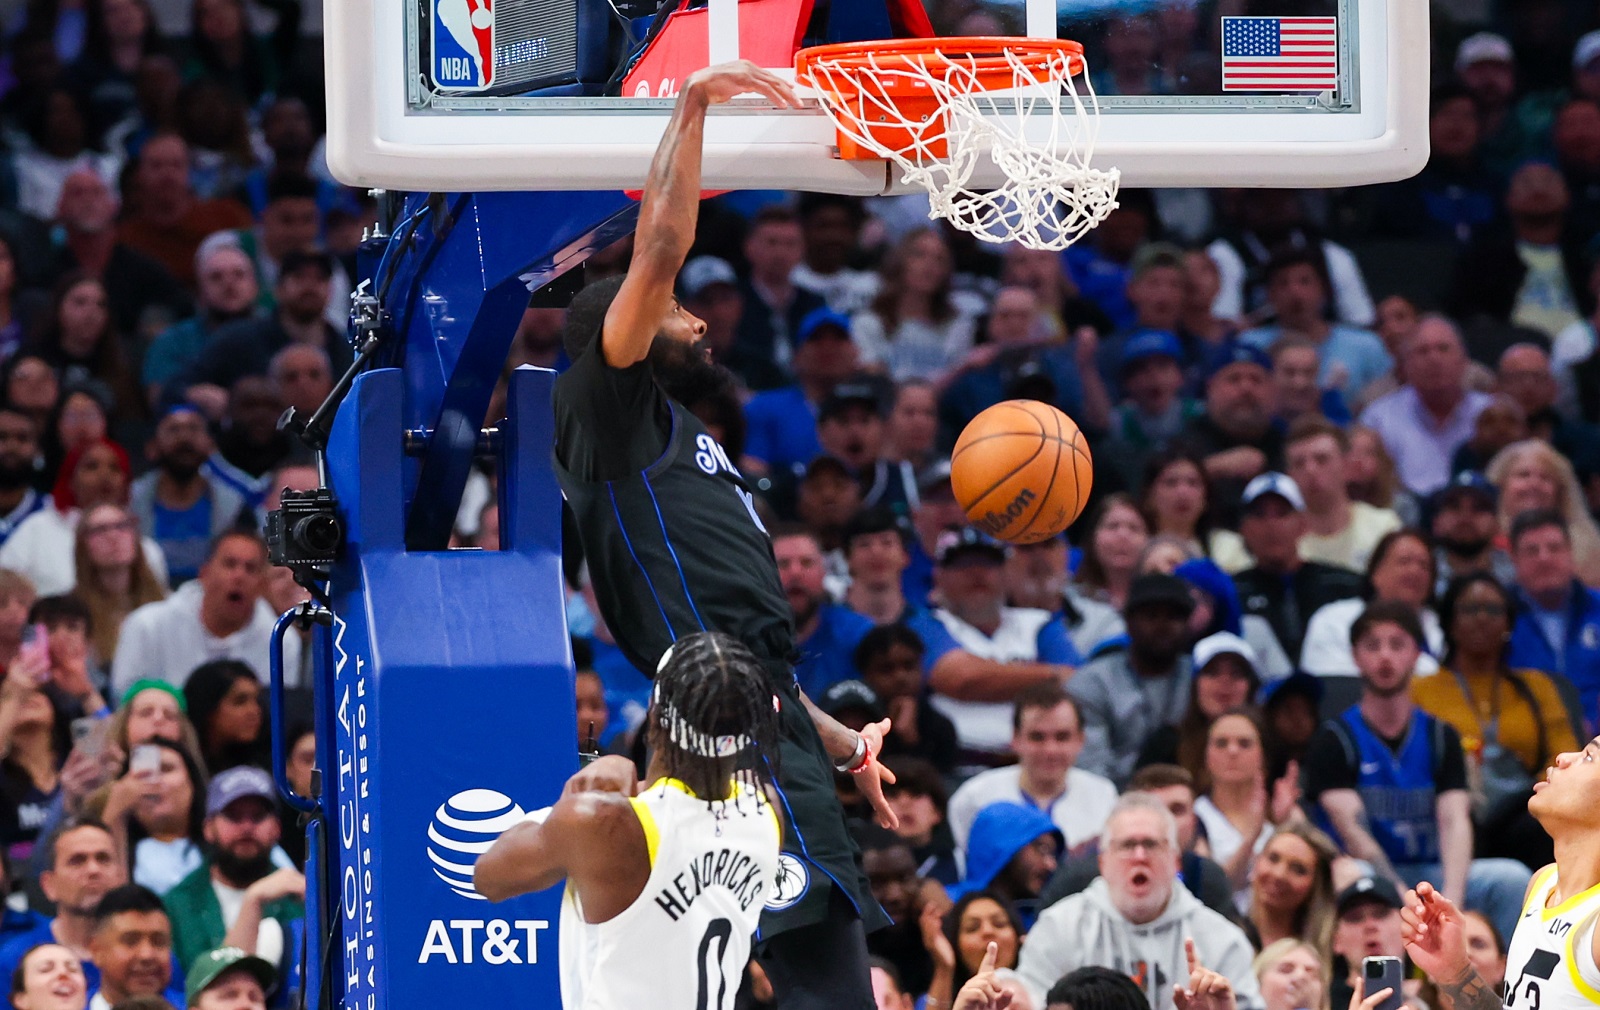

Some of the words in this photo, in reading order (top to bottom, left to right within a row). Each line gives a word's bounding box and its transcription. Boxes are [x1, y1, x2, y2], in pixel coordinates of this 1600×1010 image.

[441, 57, 471, 81] NBA
[356, 654, 369, 799] RESORT
[333, 610, 360, 1010] HOCTAW
[361, 812, 370, 834] &
[654, 848, 763, 922] HENDRICKS
[418, 918, 549, 965] AT&T
